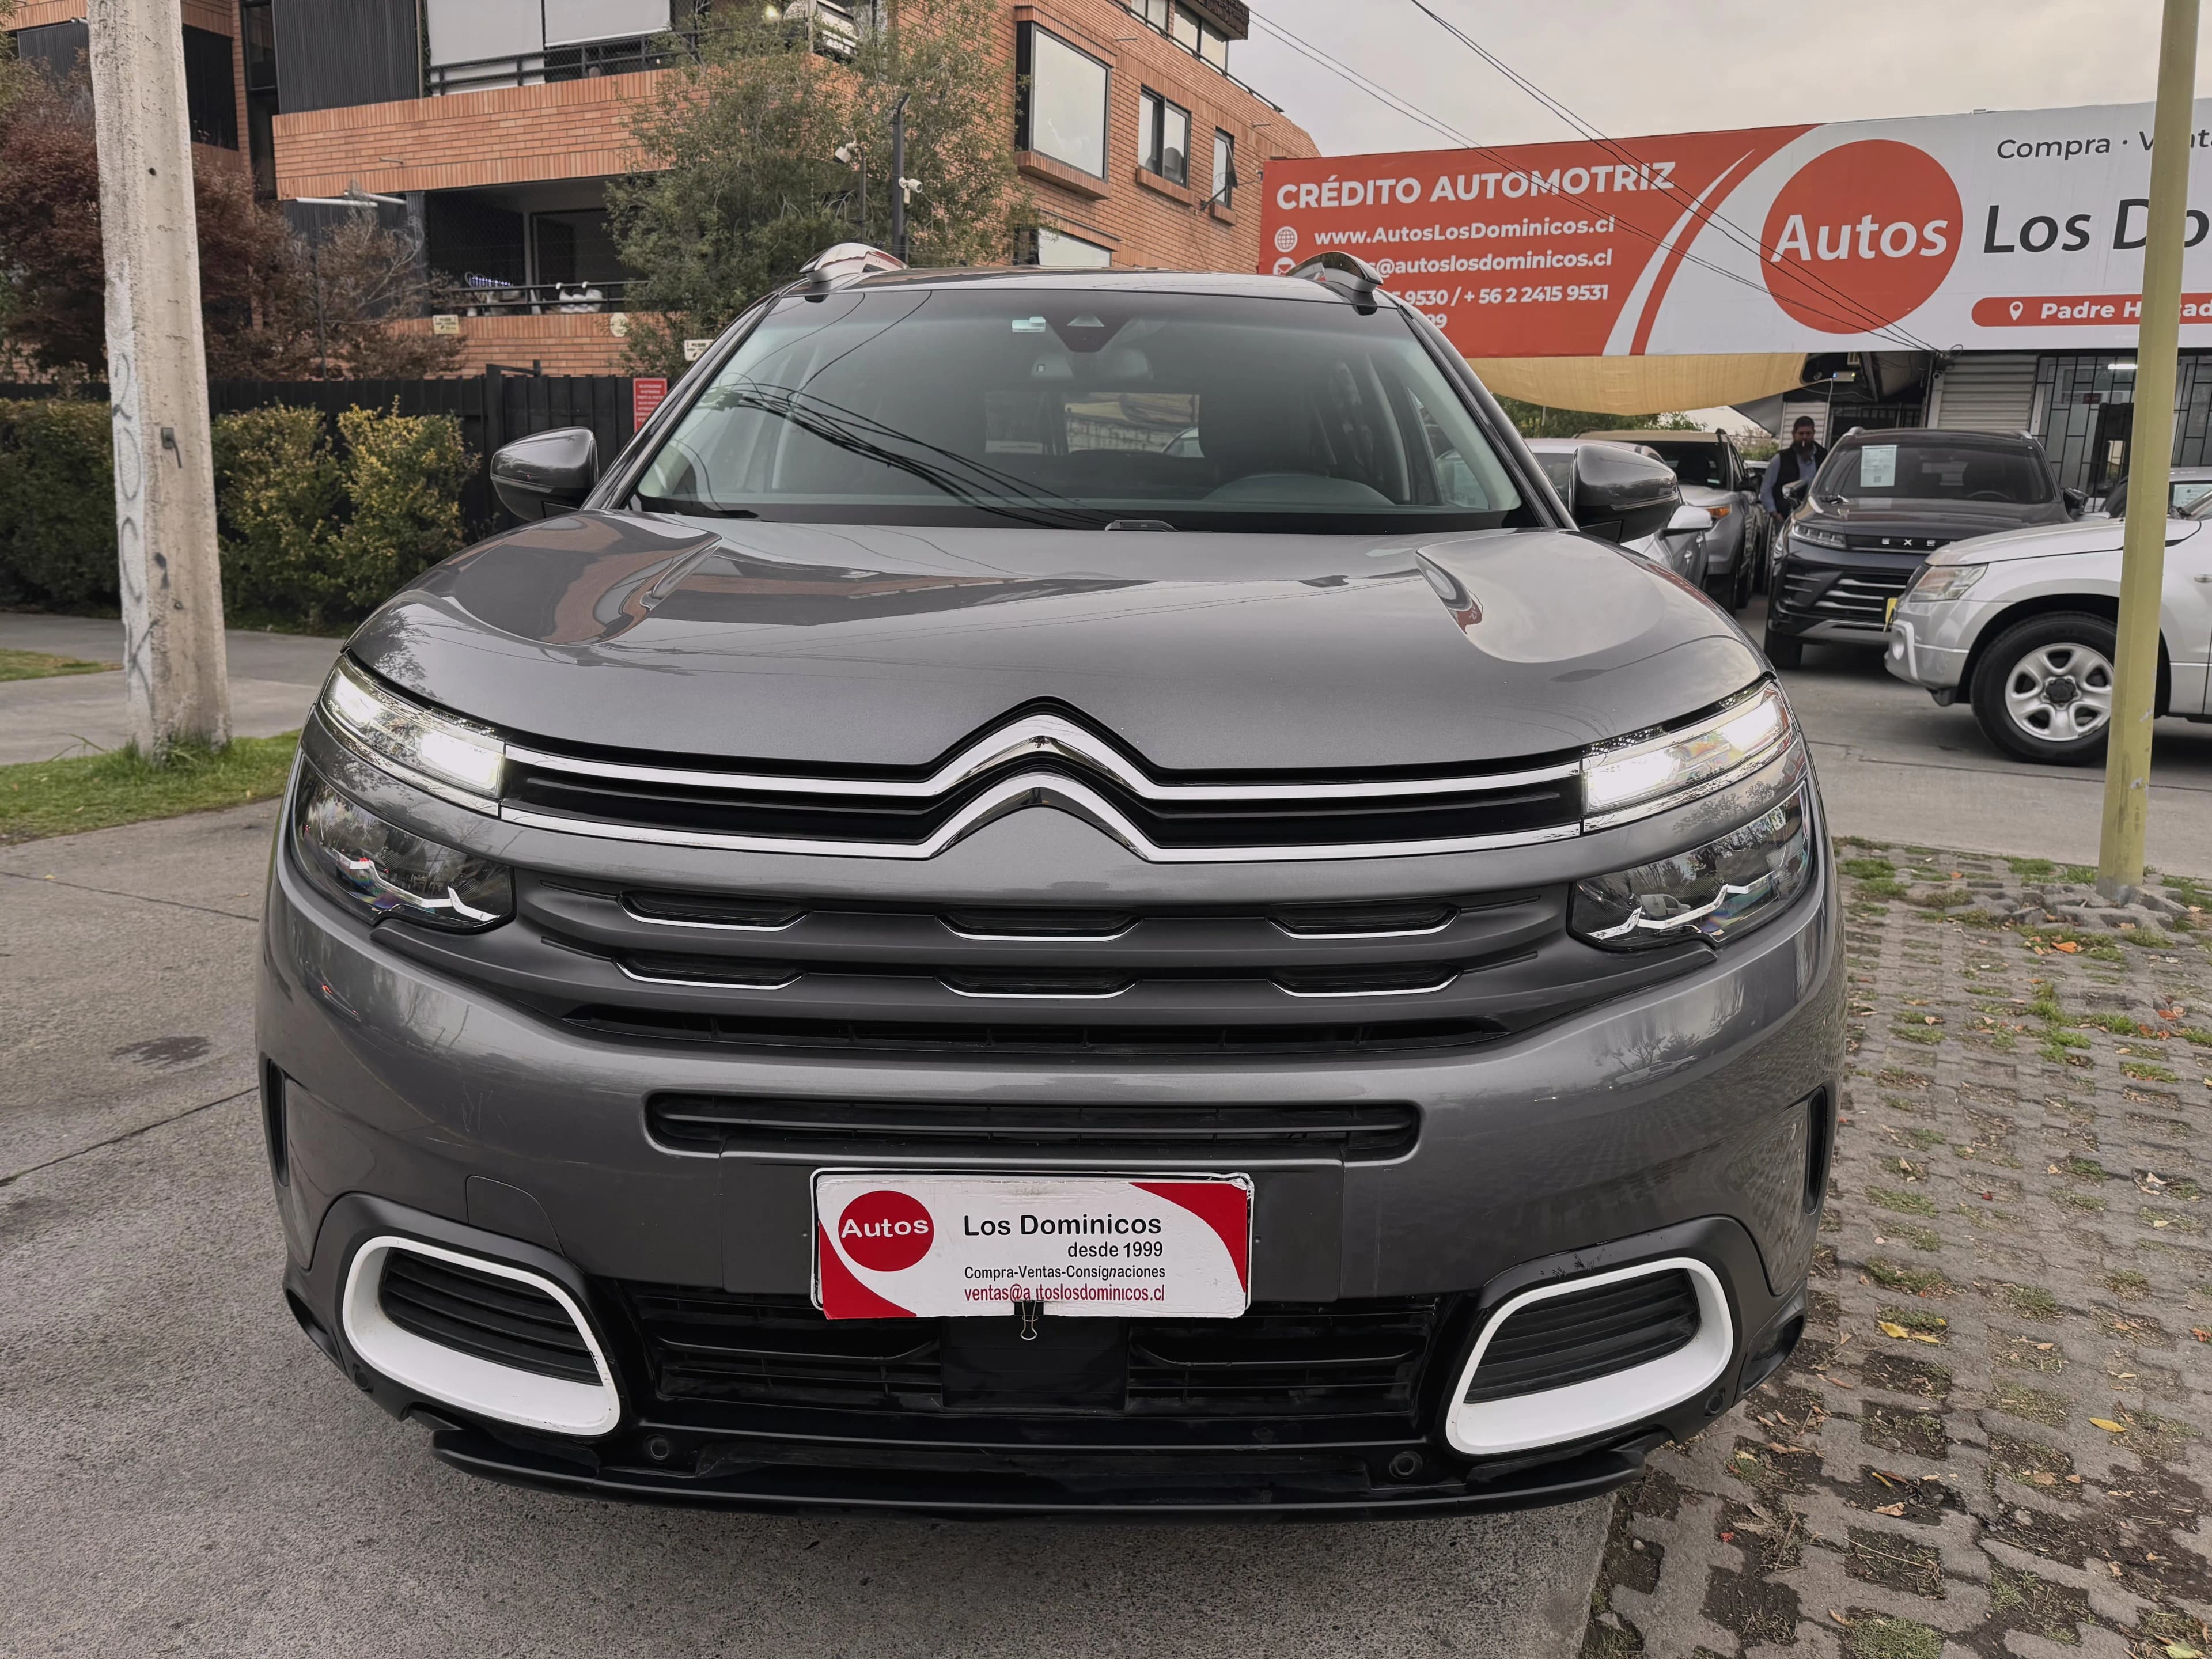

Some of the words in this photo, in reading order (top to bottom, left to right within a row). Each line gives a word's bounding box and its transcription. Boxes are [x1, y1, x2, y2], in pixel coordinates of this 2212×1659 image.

[1996, 136, 2111, 162] Compra
[1276, 175, 1421, 210] CRÉDITO
[1430, 162, 1676, 202] AUTOMOTRIZ
[1314, 215, 1615, 245] www.AutosLosDominicos.cl
[1771, 214, 1949, 263] Autos
[1983, 204, 2091, 254] Los
[1370, 248, 1612, 278] s@autoslosdominicos.cl
[1404, 290, 1449, 306] 9530
[1479, 288, 1502, 304] 56
[1506, 287, 1517, 303] 2
[1521, 286, 1562, 302] 2415
[1567, 284, 1609, 301] 9531
[2041, 301, 2115, 319] Padre
[840, 1217, 929, 1239] Autos
[963, 1215, 1011, 1236] Los
[1020, 1213, 1162, 1235] Dominicos
[1067, 1241, 1118, 1257] desde
[1123, 1241, 1164, 1257] 1999
[964, 1264, 1166, 1281] Compra-Ventas-Consignaciones
